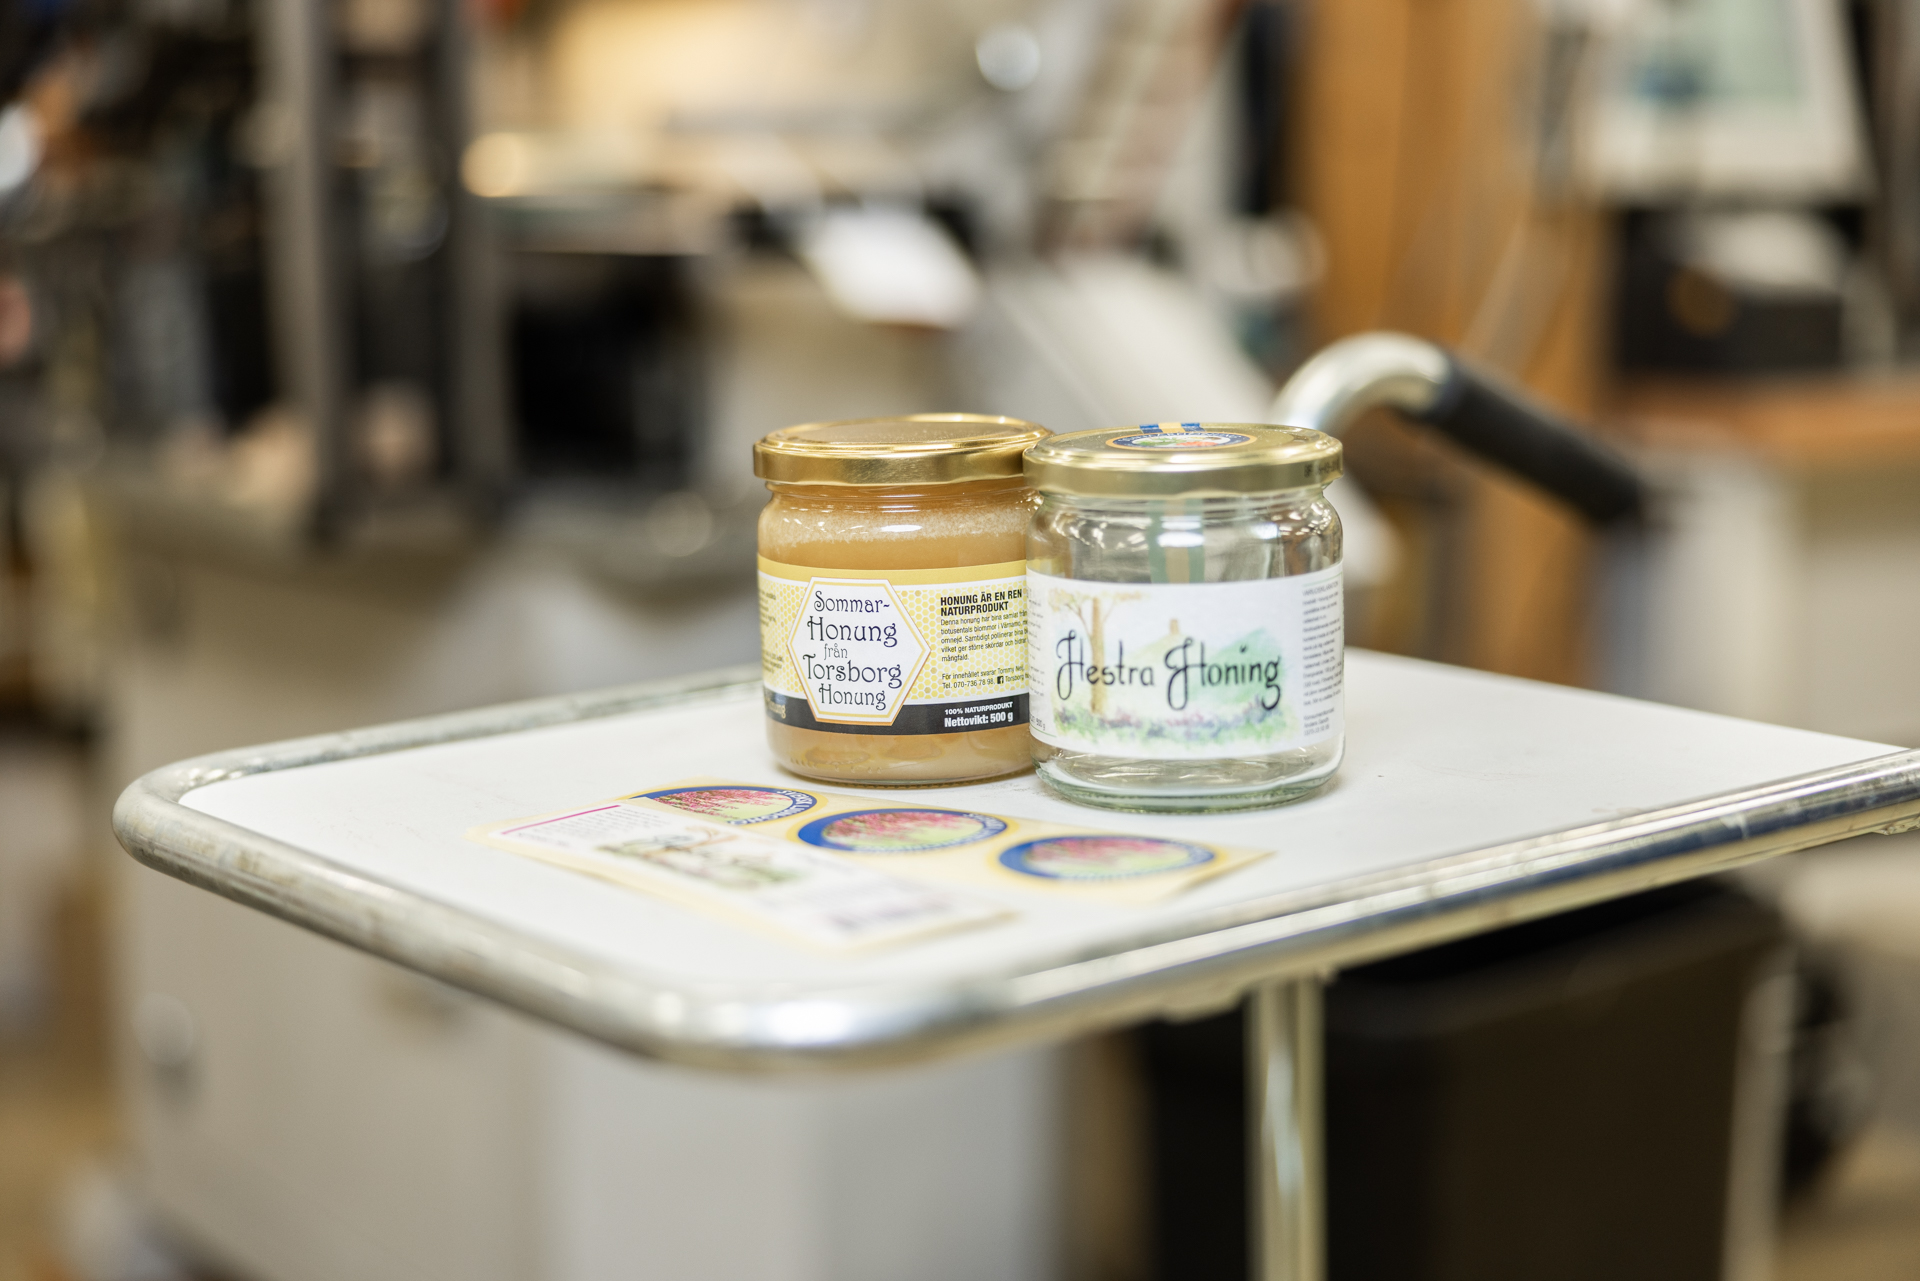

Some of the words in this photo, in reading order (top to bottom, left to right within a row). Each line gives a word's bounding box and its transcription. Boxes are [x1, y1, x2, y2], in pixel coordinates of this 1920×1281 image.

[813, 590, 890, 613] Sommar-
[940, 594, 978, 606] HONUNG
[980, 591, 992, 602] ÄR
[994, 591, 1005, 601] EN
[1007, 588, 1023, 600] REN
[940, 601, 1009, 616] NATURPRODUKT
[940, 618, 959, 626] Denna
[960, 616, 980, 624] honung
[981, 614, 990, 622] har
[806, 615, 898, 648] Honung
[973, 624, 997, 633] blommor
[940, 635, 964, 645] omnejd.
[964, 633, 990, 642] Samtidigt
[984, 641, 1004, 649] skördar
[824, 643, 848, 661] från
[941, 654, 970, 663] mångfald.
[802, 653, 903, 689] Torsborg
[952, 670, 980, 679] innehållet
[997, 667, 1015, 675] Tommy
[1055, 629, 1155, 700] Hestra
[1164, 636, 1282, 711] Honing
[953, 679, 978, 688] 070-736
[1005, 673, 1025, 682] Torsborg
[818, 683, 887, 711] Honung
[944, 707, 964, 715] 100%
[964, 701, 1014, 713] NATURPRODUKT
[944, 714, 989, 727] Nettovikt:
[989, 711, 1007, 723] 500
[1007, 712, 1014, 722] g
